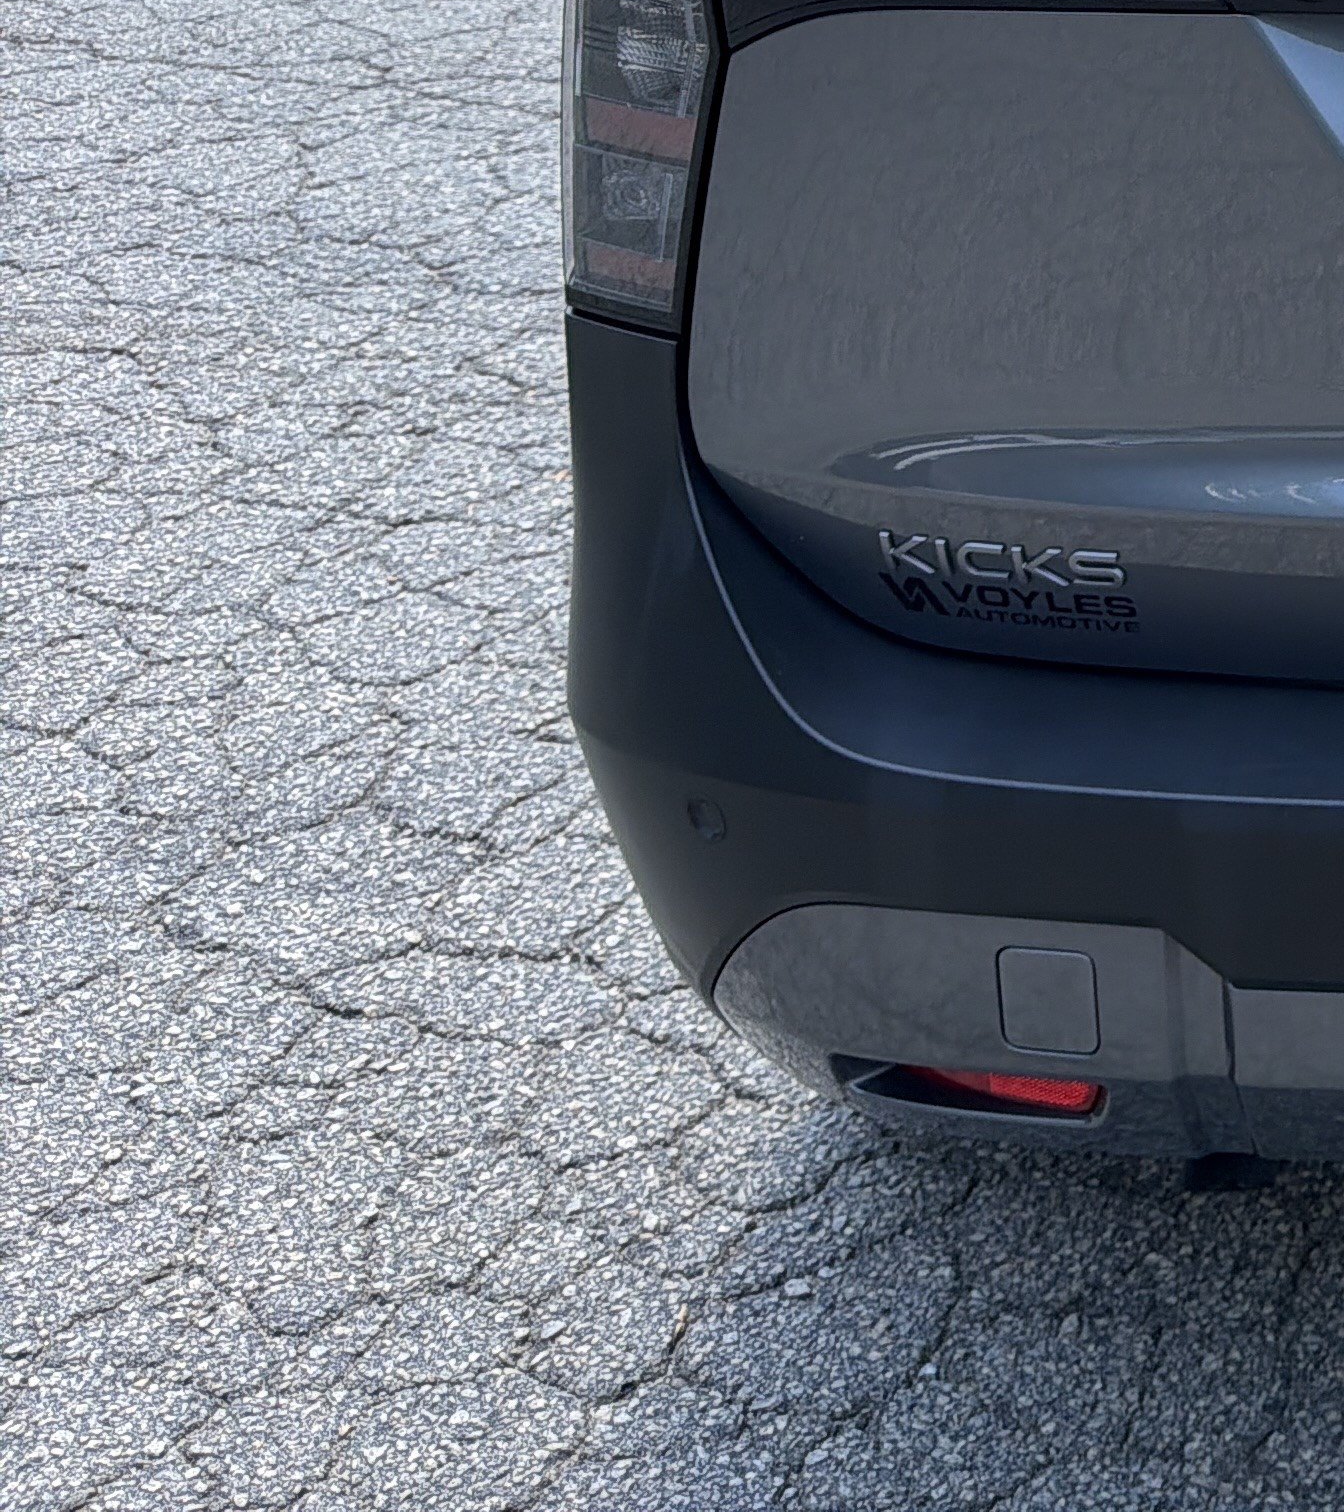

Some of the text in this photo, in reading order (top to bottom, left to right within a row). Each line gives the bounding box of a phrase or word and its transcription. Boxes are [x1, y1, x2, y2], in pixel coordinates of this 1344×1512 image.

[878, 529, 1127, 587] KICKS
[941, 580, 1137, 618] VOYLES
[955, 606, 1141, 634] AUTOMOTIVE
